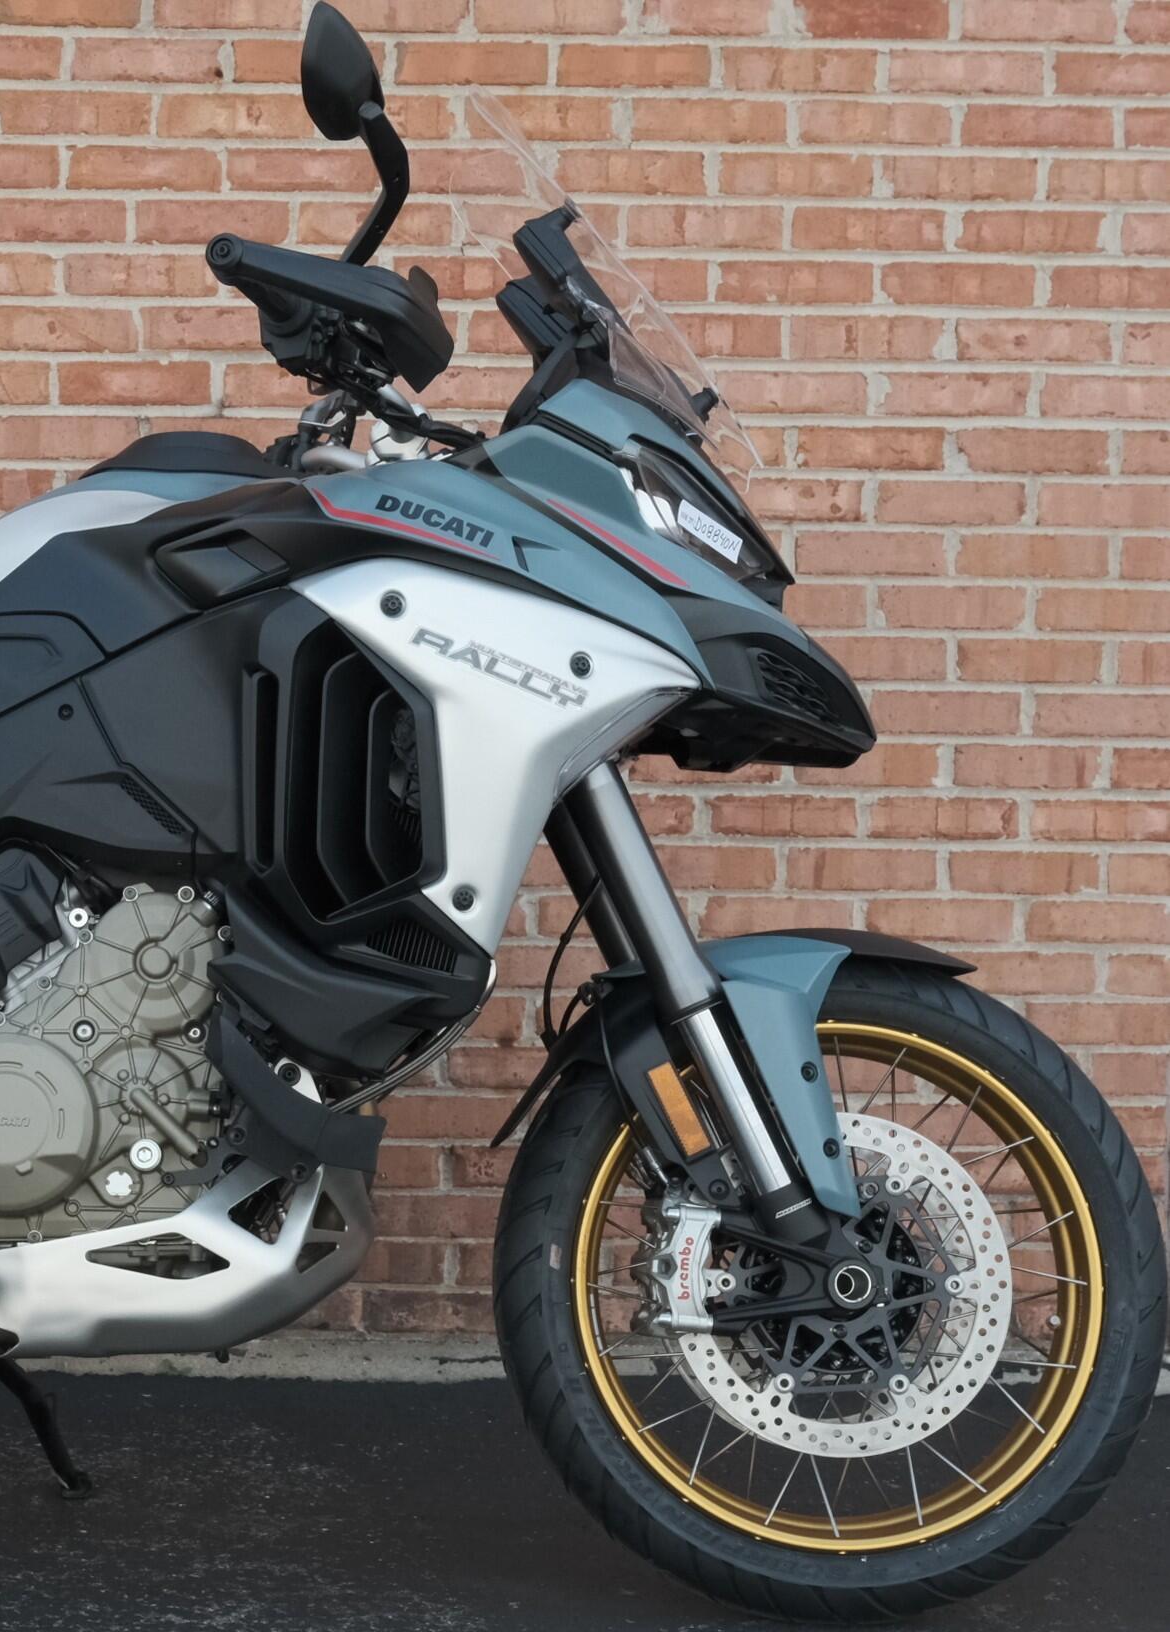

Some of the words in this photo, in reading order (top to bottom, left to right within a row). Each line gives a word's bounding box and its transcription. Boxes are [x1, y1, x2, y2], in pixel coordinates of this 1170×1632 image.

[375, 494, 494, 548] DUCATI
[411, 628, 587, 709] RALLY
[677, 1236, 695, 1302] brembo
